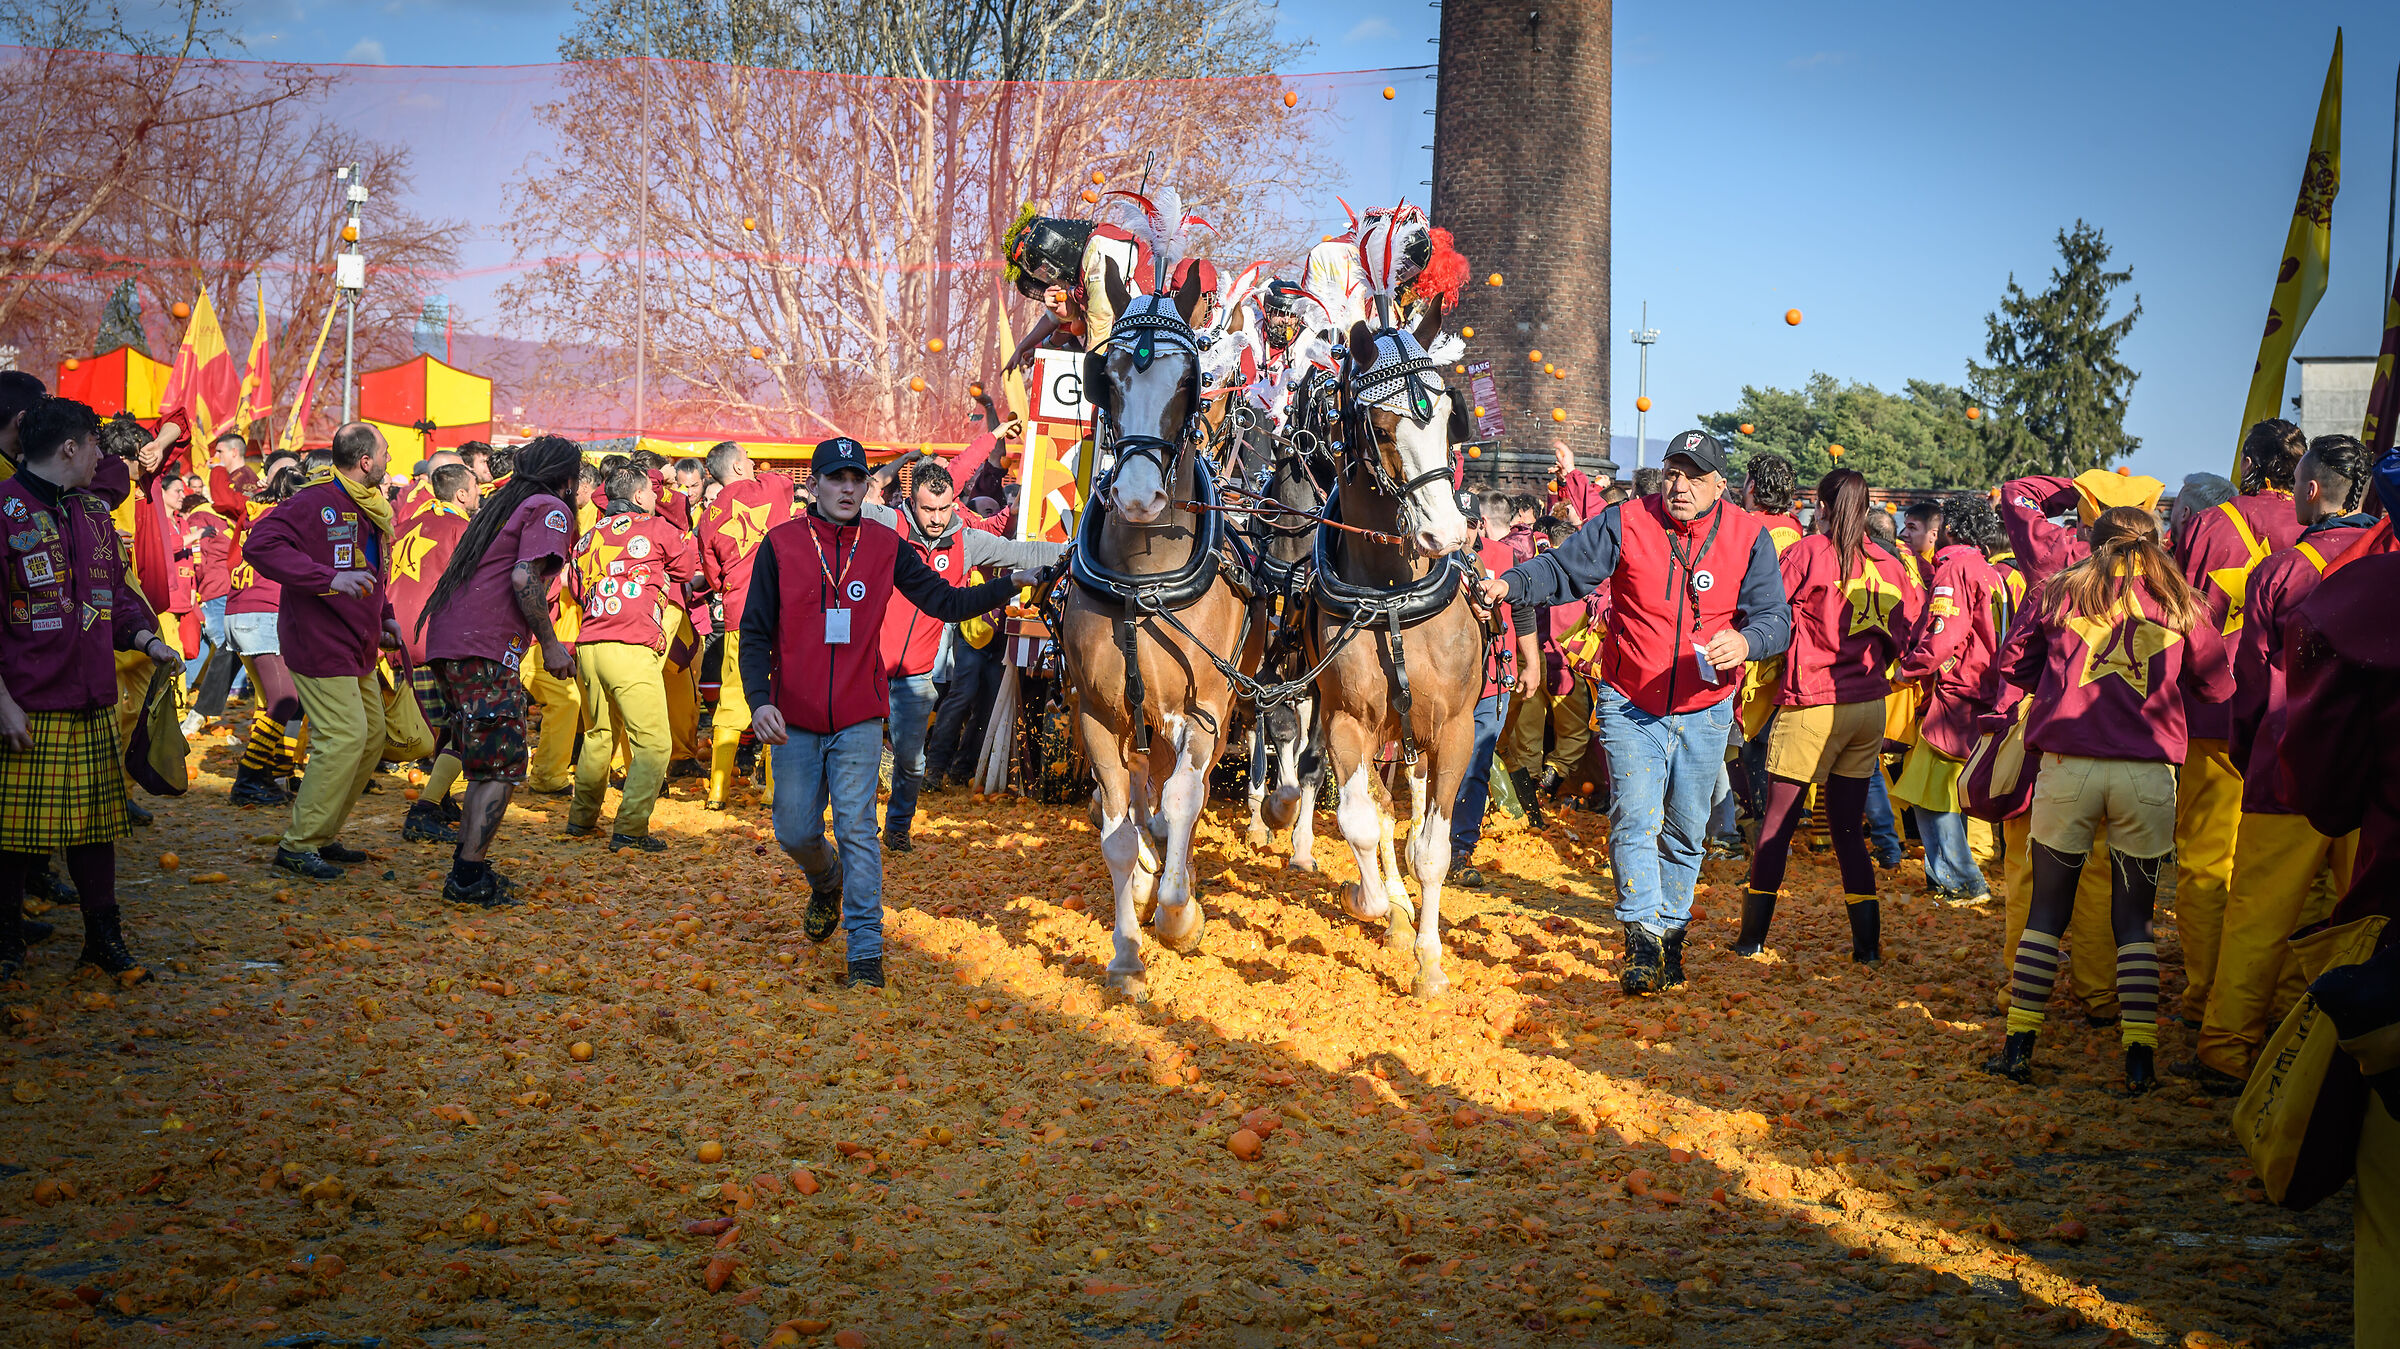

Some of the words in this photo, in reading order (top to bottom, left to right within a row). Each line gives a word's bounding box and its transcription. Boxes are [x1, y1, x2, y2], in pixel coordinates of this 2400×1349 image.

[1053, 373, 1083, 406] G
[937, 557, 947, 569] G
[1697, 574, 1711, 589] G
[850, 583, 863, 598] G
